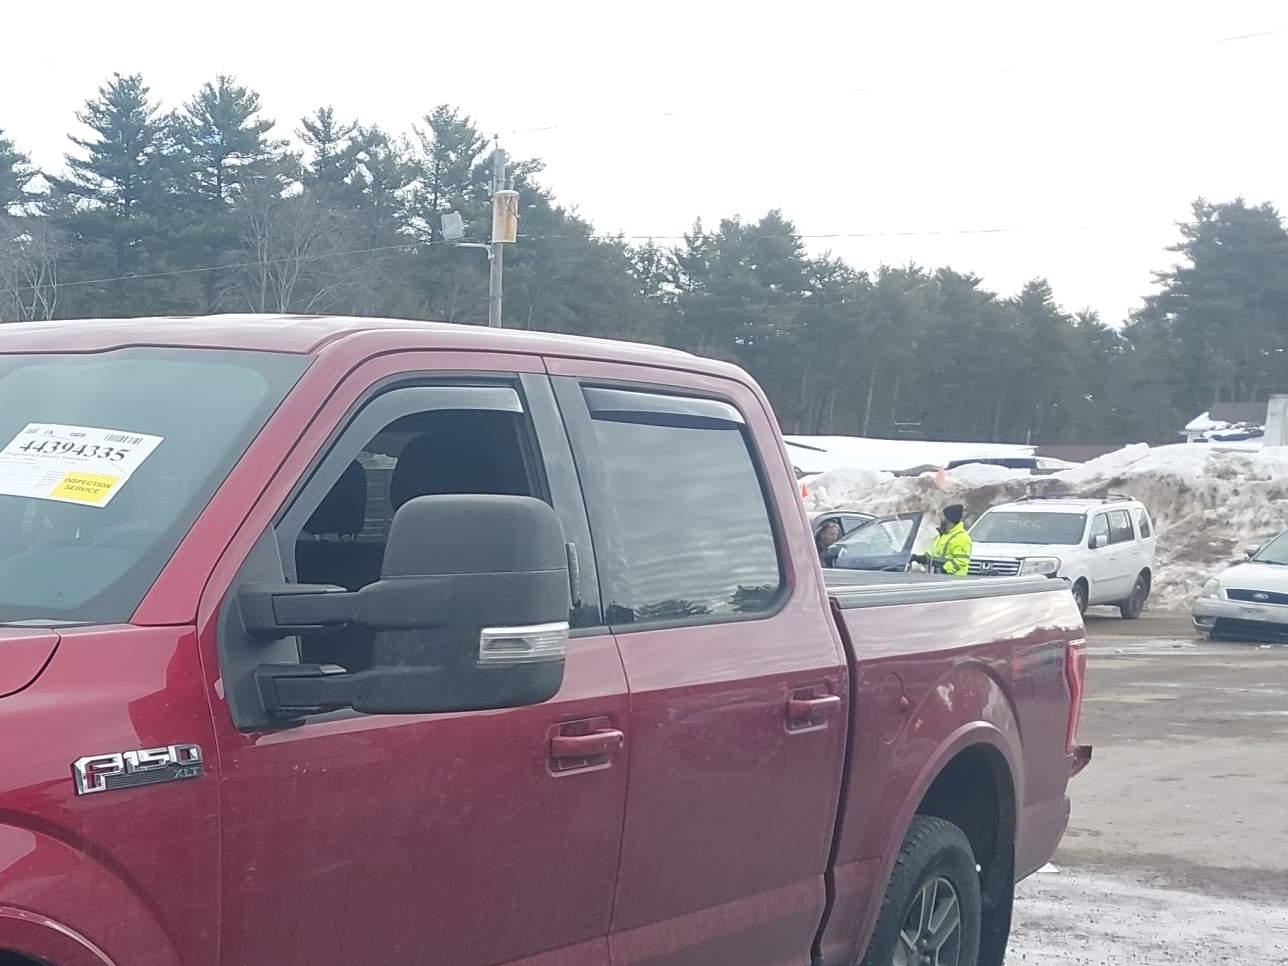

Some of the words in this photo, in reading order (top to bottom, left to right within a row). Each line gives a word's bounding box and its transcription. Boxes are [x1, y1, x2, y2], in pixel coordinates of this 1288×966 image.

[19, 440, 132, 462] 44394335
[64, 476, 113, 489] INSPECTION
[64, 484, 101, 495] SERVICE
[173, 766, 201, 779] XLT
